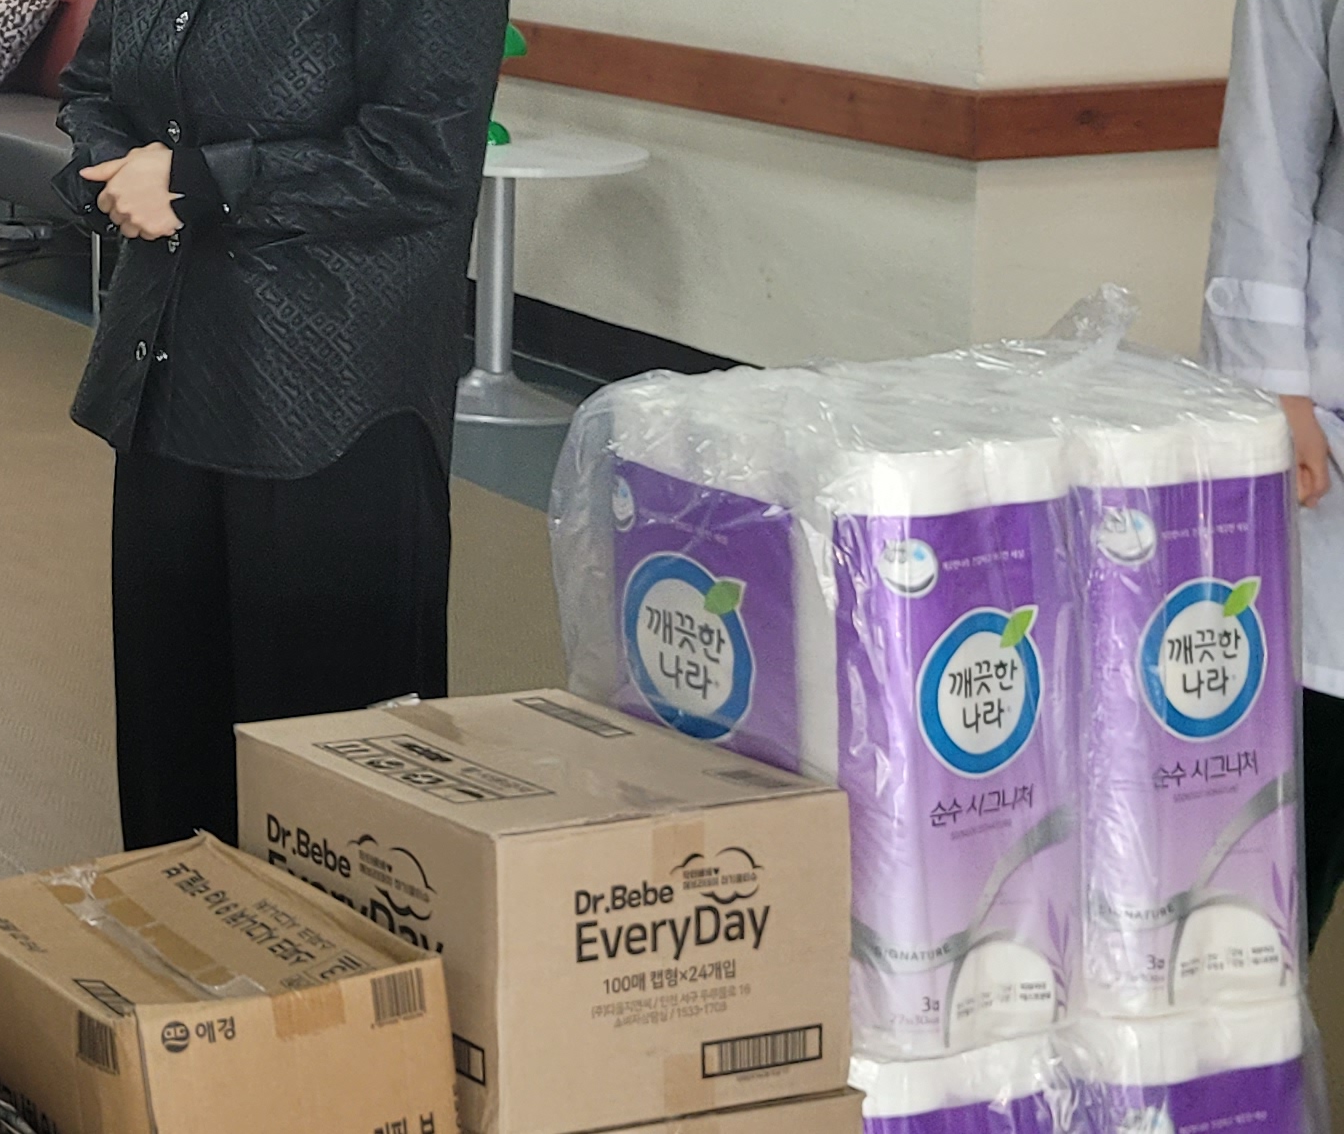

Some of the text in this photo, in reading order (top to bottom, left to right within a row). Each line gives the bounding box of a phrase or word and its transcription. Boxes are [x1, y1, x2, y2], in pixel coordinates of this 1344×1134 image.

[646, 606, 725, 664] 깨끗한
[1167, 628, 1241, 664] 깨끗한
[659, 651, 712, 699] 나라
[948, 659, 1018, 698] 깨끗한
[1182, 665, 1229, 700] 나라
[962, 699, 1005, 733] 나라
[1152, 749, 1259, 790] 순수 시그니처
[930, 783, 1034, 827] 순수 시그니처
[266, 813, 351, 879] Dr.Bebe
[575, 880, 675, 915] Dr.Bebe
[576, 905, 771, 963] EveryDay
[603, 972, 646, 995] 100매
[196, 1017, 237, 1044] 애경
